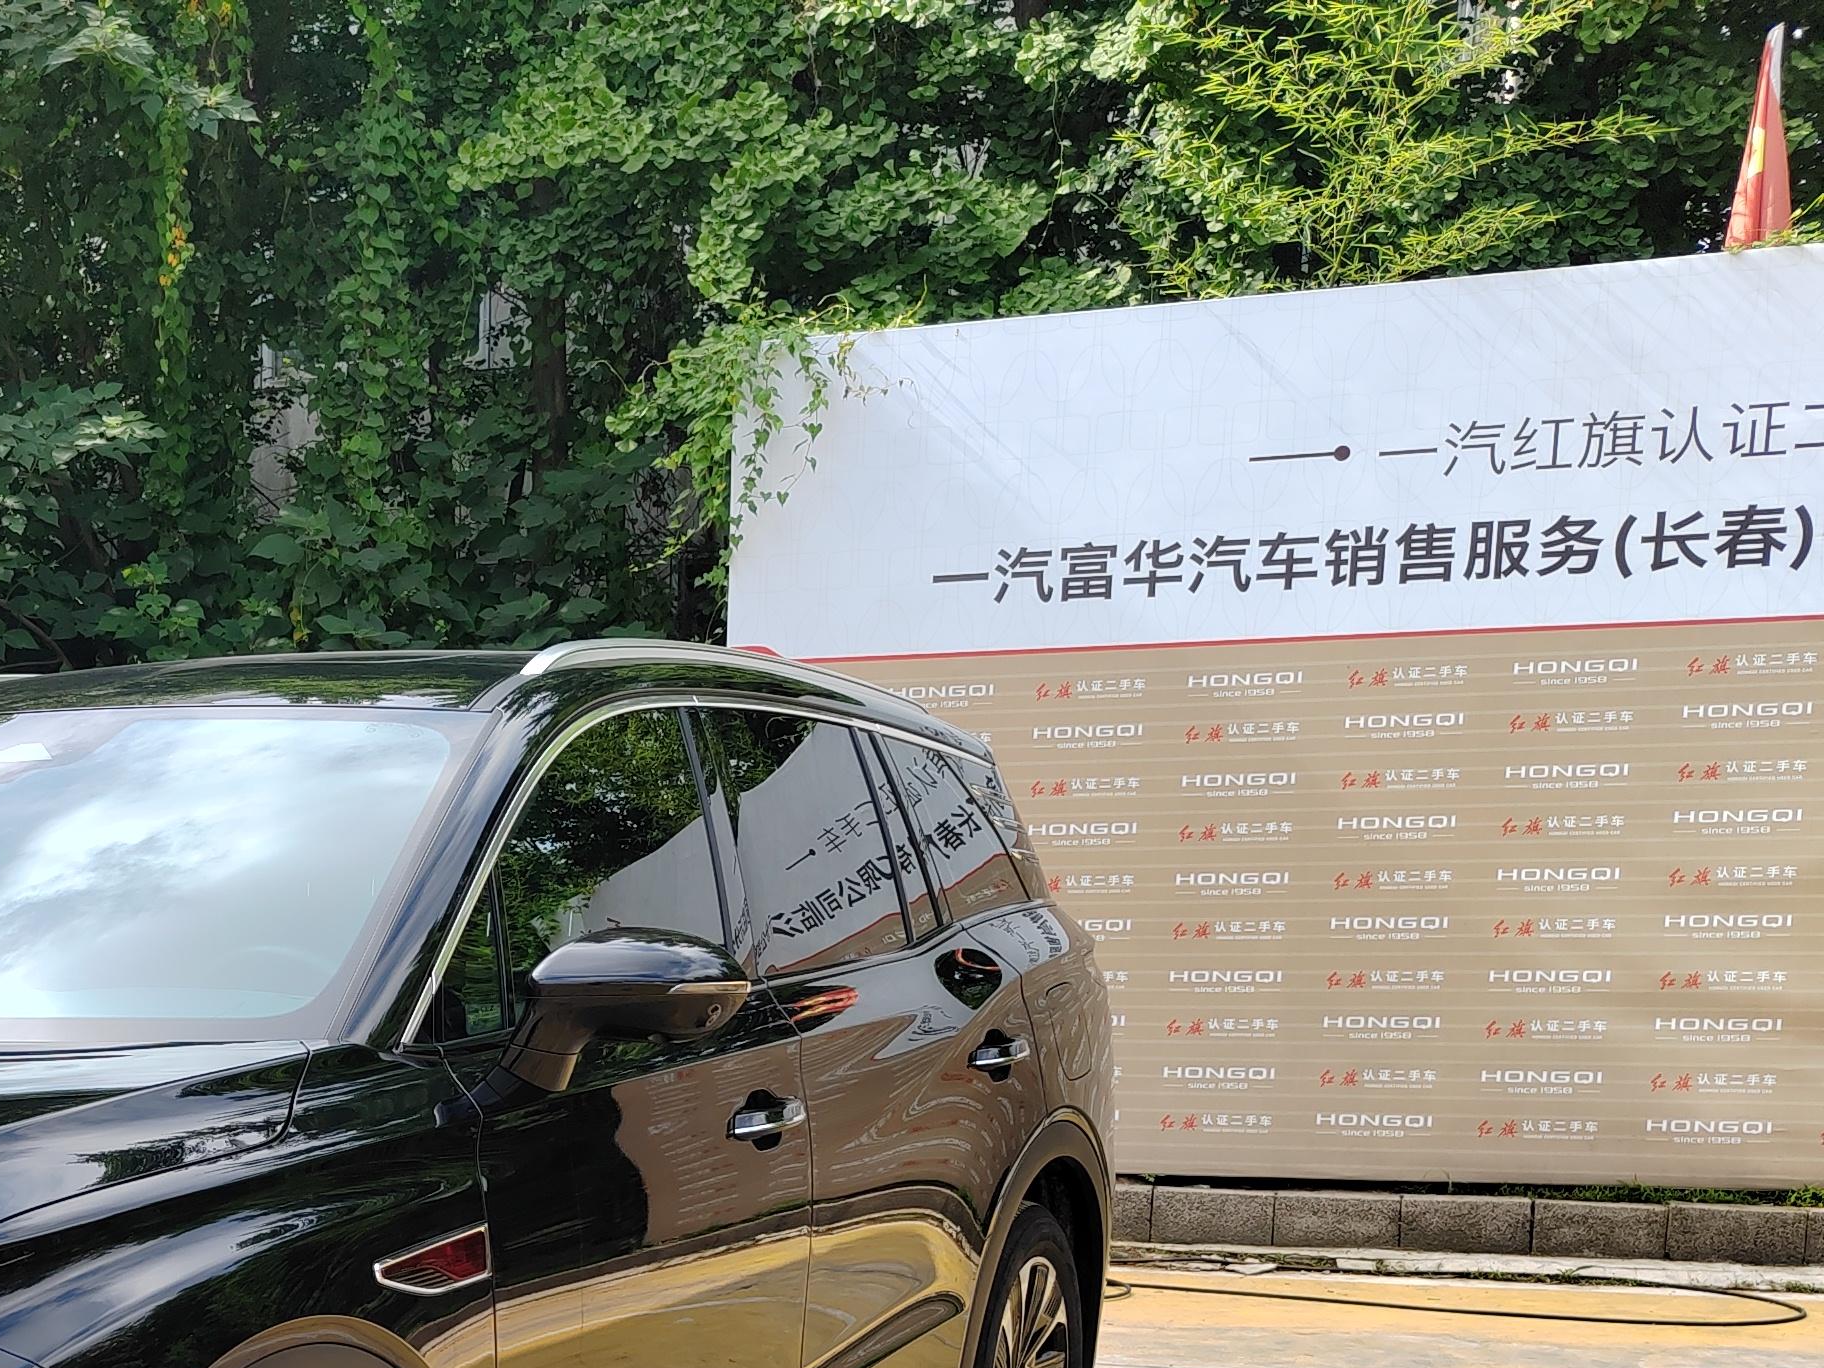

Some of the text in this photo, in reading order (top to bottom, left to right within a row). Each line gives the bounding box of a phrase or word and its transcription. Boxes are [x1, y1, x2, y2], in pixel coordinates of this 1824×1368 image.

[1512, 657, 1638, 676] HONGQI
[1734, 651, 1818, 668] 认证二手车
[1187, 670, 1303, 688] HONGQI
[1392, 664, 1468, 680] 认证二手车
[1076, 678, 1146, 692] 认证二手车
[1539, 675, 1608, 686] since 1958
[1212, 688, 1275, 698] since 1958
[1682, 701, 1813, 719] HONGQI
[1344, 711, 1465, 729] HONGQI
[1554, 710, 1634, 725] 认证二手车
[1710, 719, 1782, 729] since 1958
[1032, 723, 1143, 740] HONGQI
[1227, 721, 1300, 735] 认证二手车
[1370, 729, 1436, 739] since 1958
[1056, 740, 1117, 749] since 1958
[1504, 763, 1630, 779] HONGQI
[1725, 759, 1808, 774] 认证二手车
[1181, 771, 1297, 788] HONGQI
[1384, 767, 1461, 782] 认证二手车
[1070, 776, 1141, 790] 认证二手车
[1531, 780, 1600, 789] since 1958
[1206, 788, 1269, 798] since 1958
[1337, 814, 1457, 830] HONGQI
[1546, 814, 1625, 829] 认证二手车
[1673, 808, 1803, 824] HONGQI
[1027, 821, 1138, 836] HONGQI
[1220, 821, 1293, 835] 认证二手车
[1701, 825, 1772, 835] since 1958
[1051, 837, 1112, 846] since 1958
[1363, 831, 1428, 840] since 1958
[1175, 871, 1289, 886] HONGQI
[1377, 869, 1453, 884] 认证二手车
[1496, 866, 1621, 881] HONGQI
[1716, 865, 1798, 880] 认证二手车
[1065, 874, 1135, 888] 认证二手车
[1523, 883, 1591, 892] since 1958
[1199, 887, 1262, 896] since 1958
[1214, 920, 1286, 933] 认证二手车
[1330, 915, 1449, 930] HONGQI
[1538, 917, 1616, 931] 认证二手车
[1664, 913, 1793, 928] HONGQI
[1355, 932, 1421, 940] since 1958
[1692, 930, 1762, 939] since 1958
[1169, 970, 1283, 984] HONGQI
[1369, 969, 1445, 983] 认证二手车
[1488, 969, 1612, 984] HONGQI
[1706, 969, 1788, 983] 认证二手车
[1193, 985, 1256, 993] since 1958
[1514, 985, 1582, 994] since 1958
[1207, 1017, 1279, 1031] 认证二手车
[1322, 1015, 1441, 1030] HONGQI
[1529, 1019, 1608, 1033] 认证二手车
[1654, 1017, 1783, 1032] HONGQI
[1347, 1031, 1413, 1039] since 1958
[1682, 1034, 1752, 1042] since 1958
[1162, 1066, 1276, 1080] HONGQI
[1362, 1068, 1437, 1082] 认证二手车
[1480, 1070, 1603, 1085] HONGQI
[1696, 1073, 1777, 1087] 认证二手车
[1186, 1082, 1249, 1090] since 1958
[1506, 1086, 1574, 1095] since 1958
[1201, 1113, 1272, 1127] 认证二手车
[1316, 1112, 1433, 1128] HONGQI
[1521, 1119, 1598, 1133] 认证二手车
[1646, 1119, 1773, 1135] HONGQI
[1341, 1129, 1405, 1138] since 1958
[1673, 1135, 1743, 1145] since 1958
